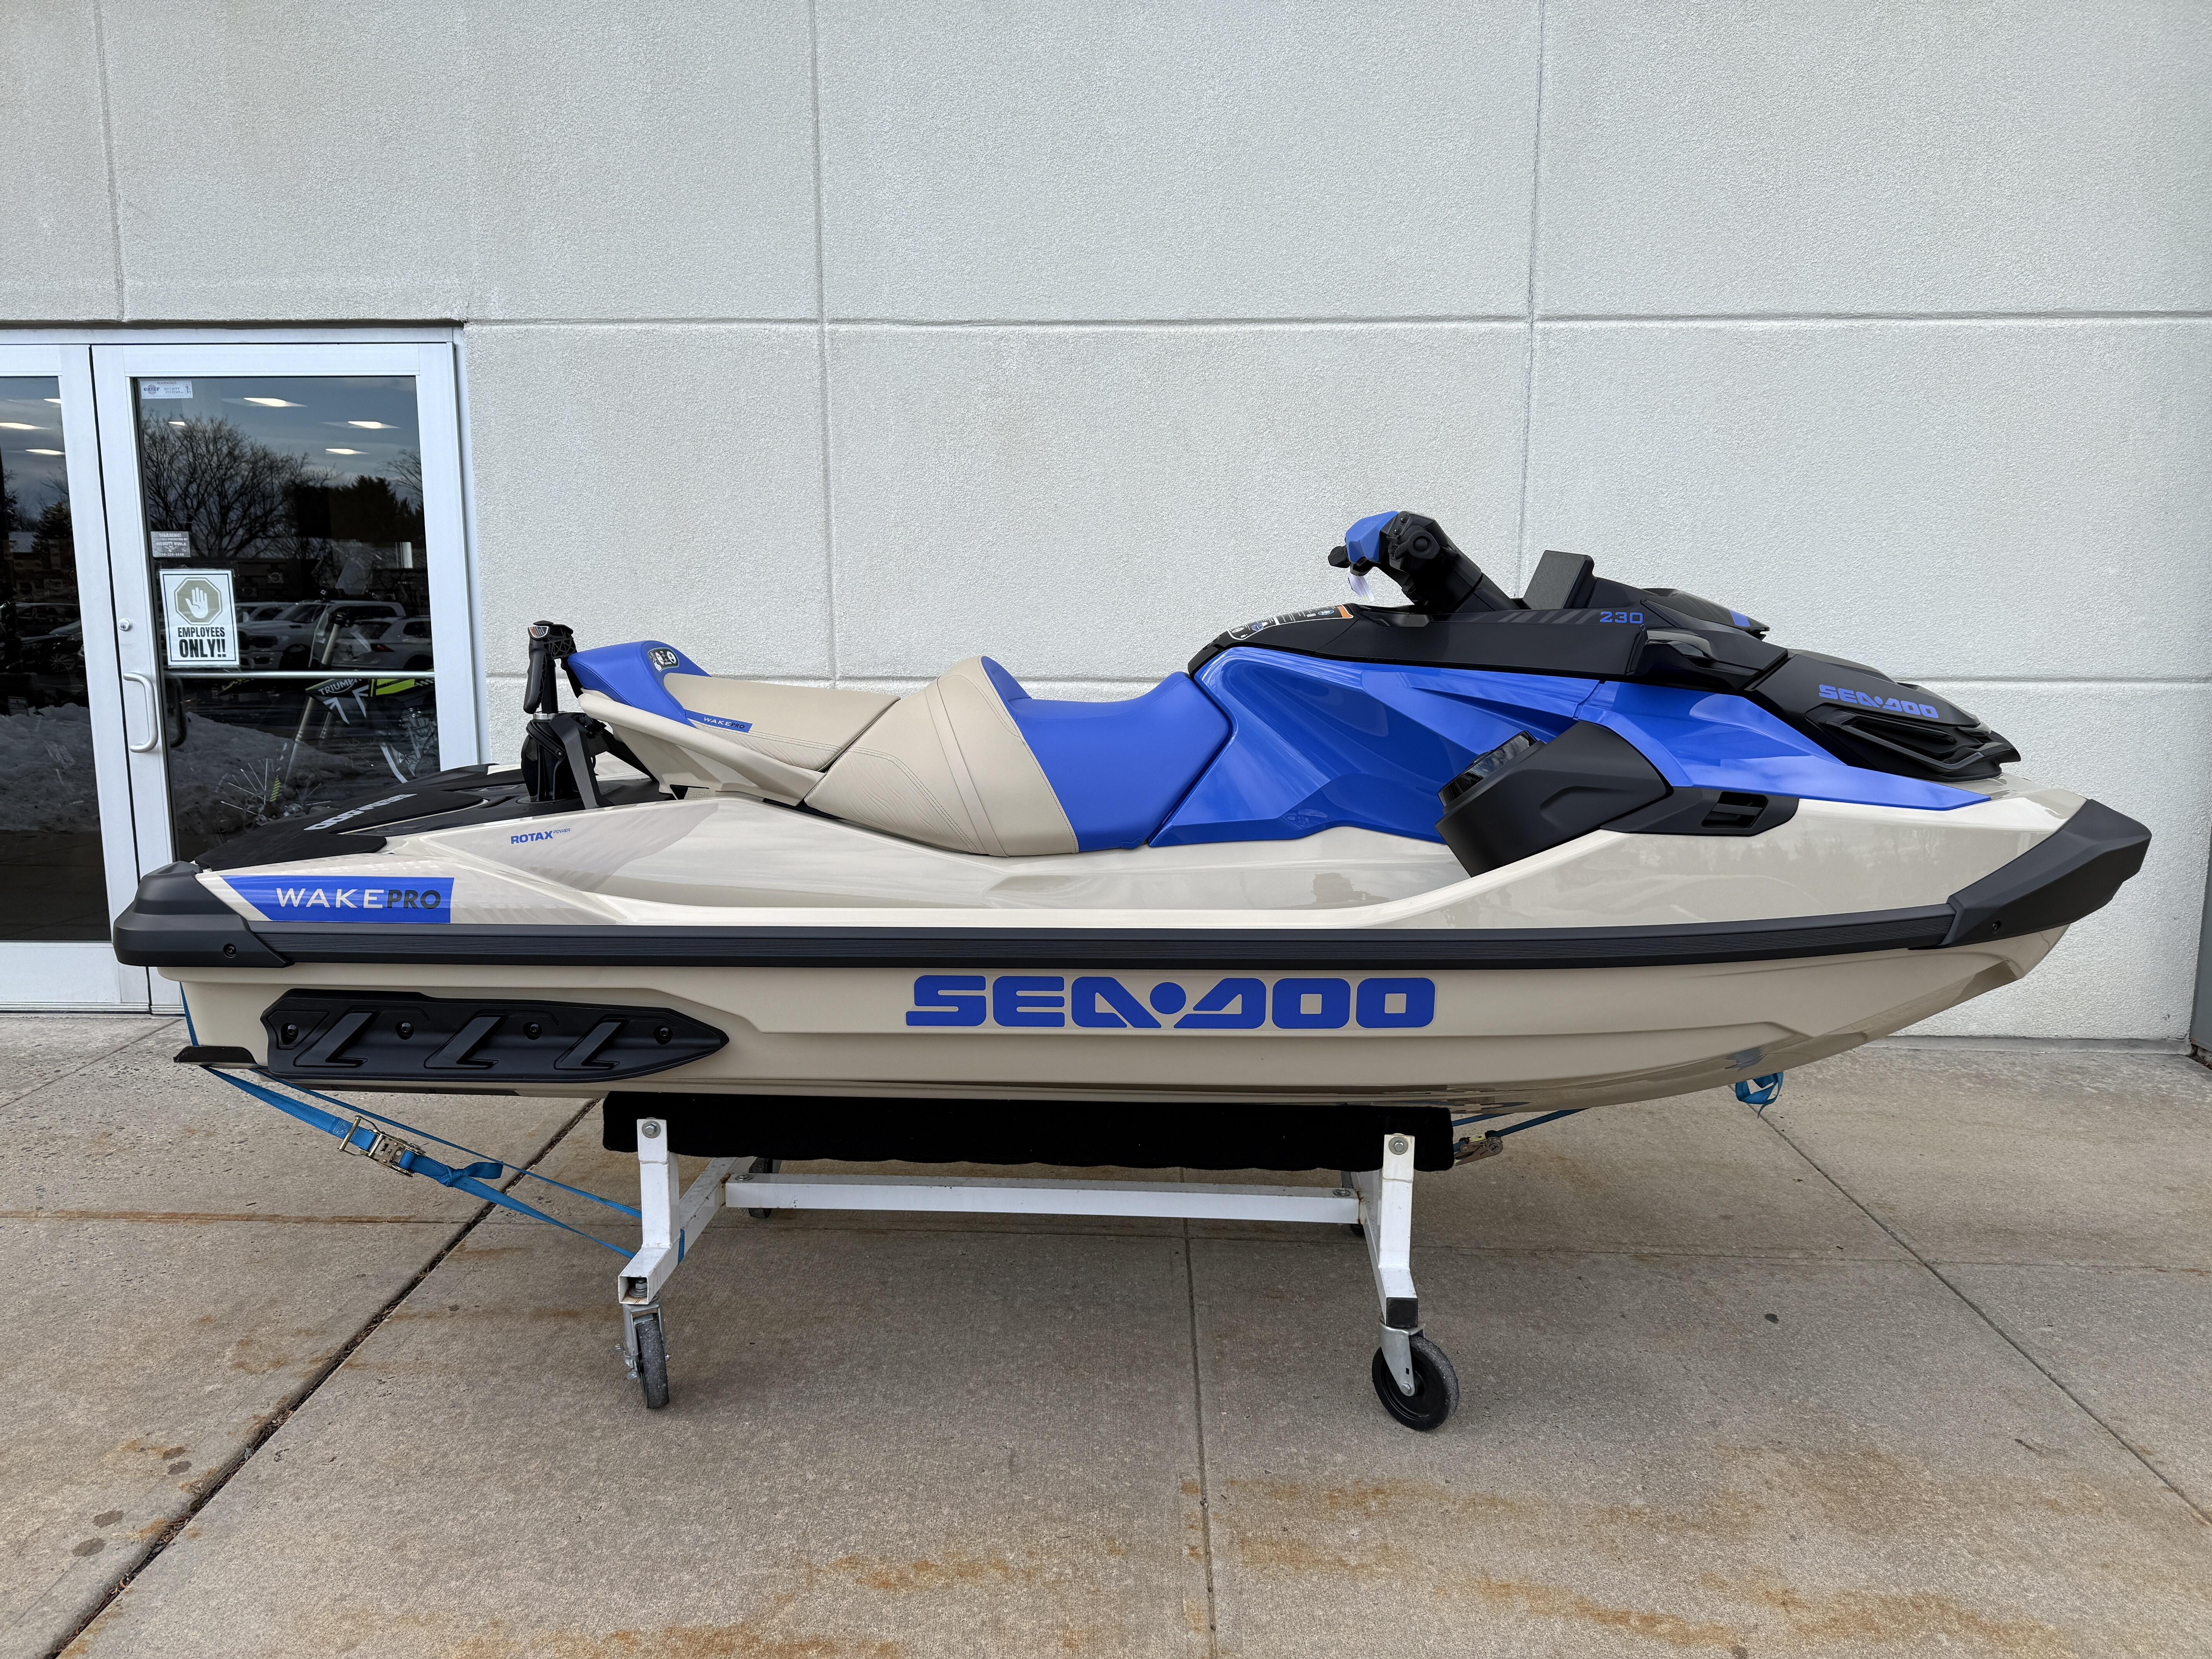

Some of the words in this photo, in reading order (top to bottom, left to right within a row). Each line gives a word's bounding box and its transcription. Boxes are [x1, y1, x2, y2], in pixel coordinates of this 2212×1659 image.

[1600, 611, 1644, 624] 230
[178, 627, 225, 637] EMPLOYEES
[179, 639, 226, 658] ONLY!!
[510, 830, 553, 844] ROTAX
